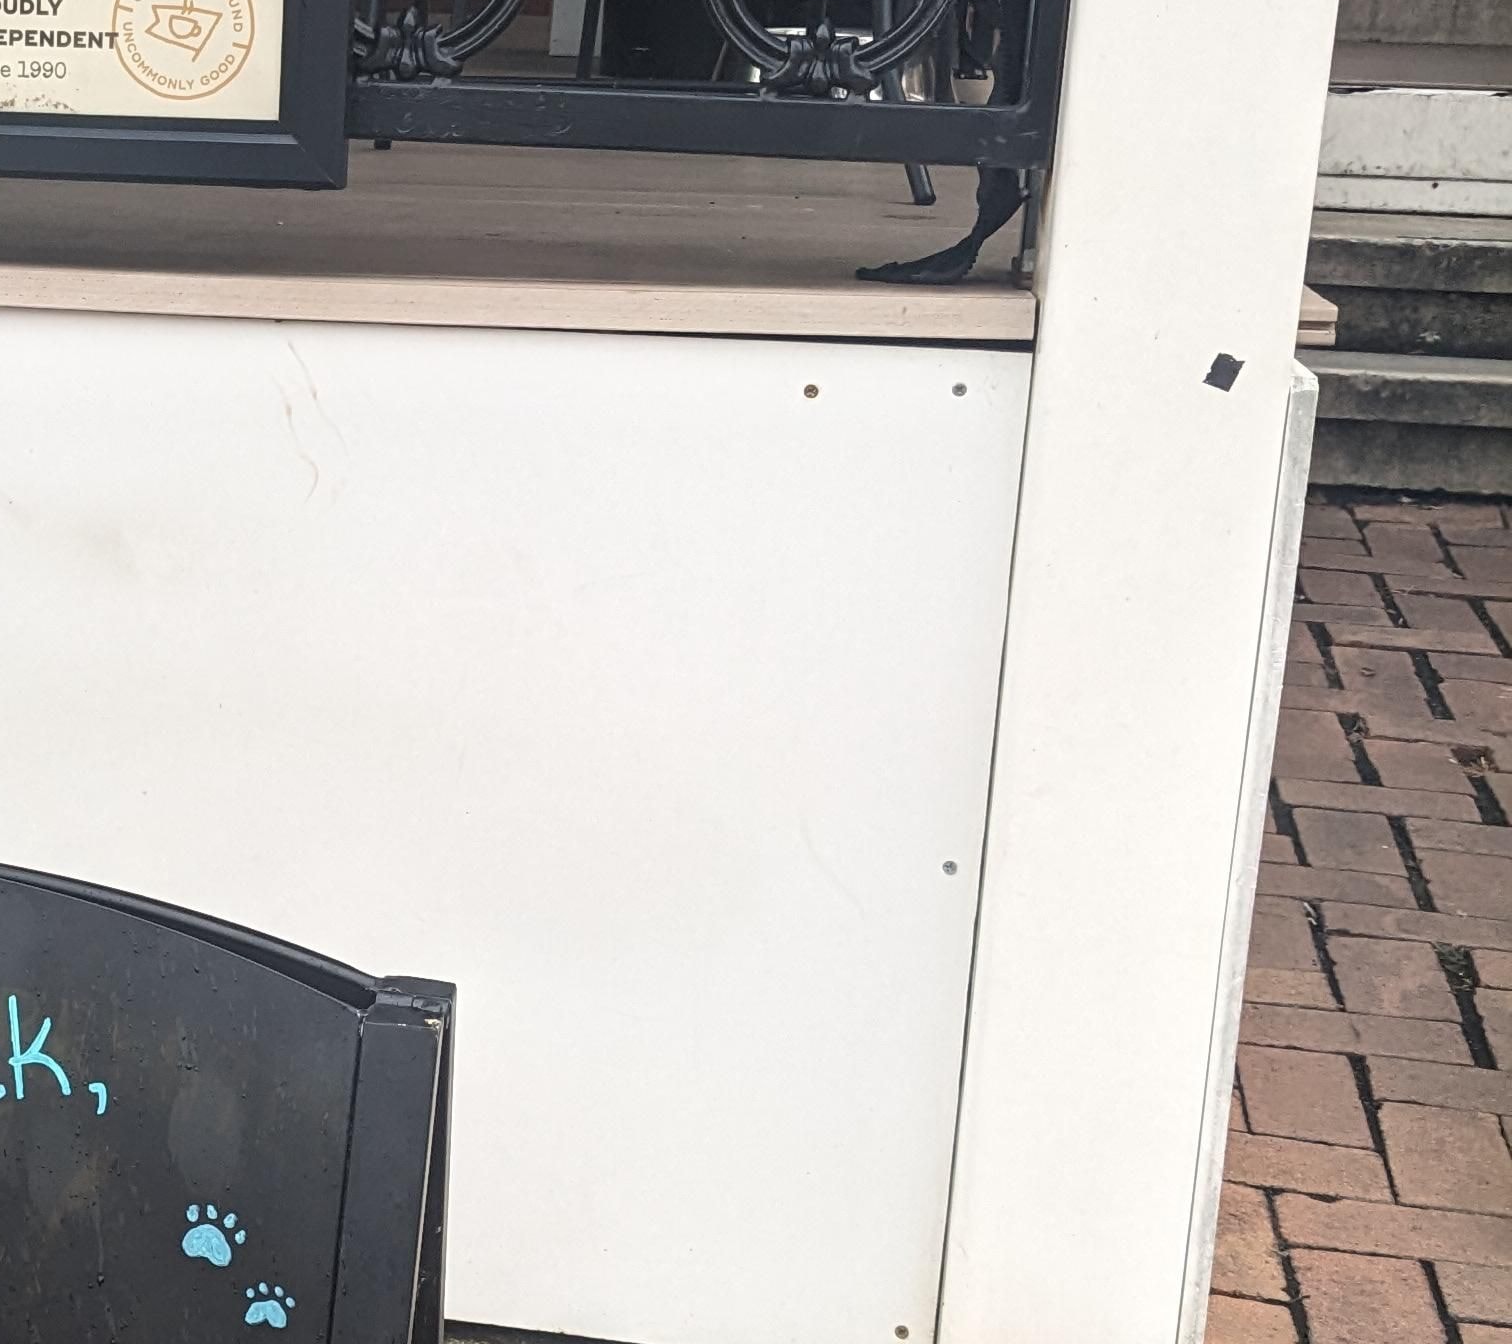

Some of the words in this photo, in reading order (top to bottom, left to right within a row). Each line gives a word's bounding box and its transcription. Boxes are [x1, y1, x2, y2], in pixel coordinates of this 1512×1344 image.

[17, 60, 67, 80] 1990
[122, 21, 194, 90] UNCOMMONLY
[200, 54, 236, 86] GOOD
